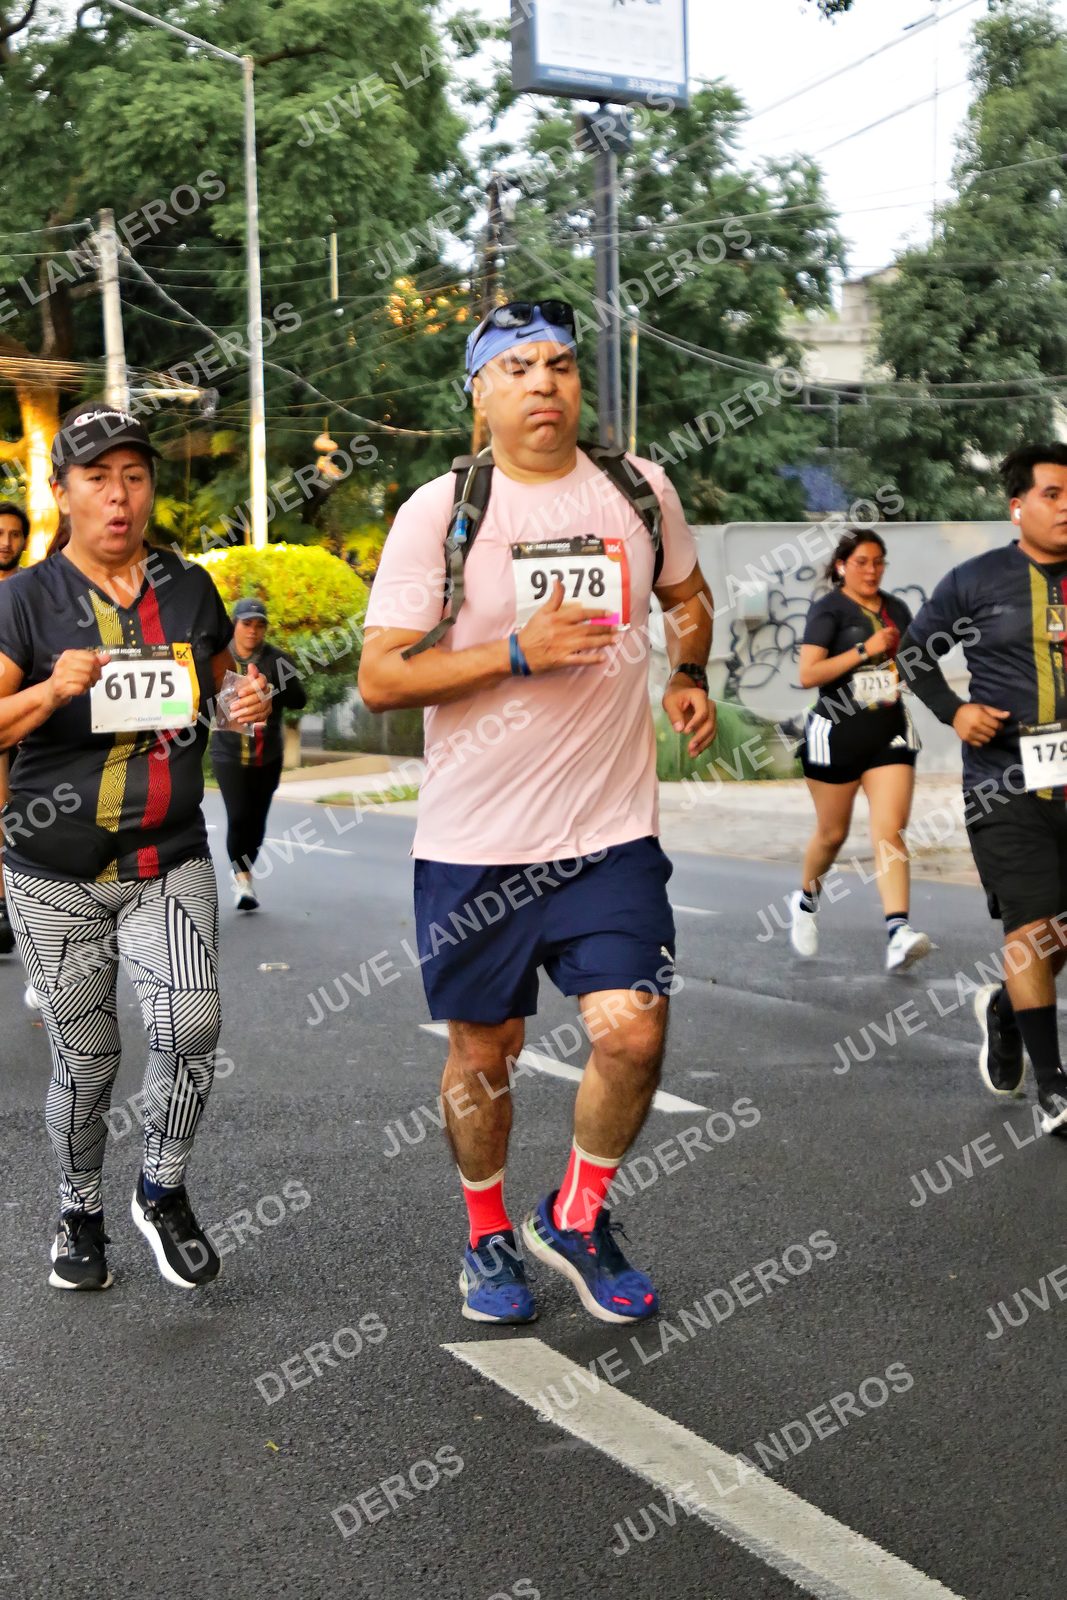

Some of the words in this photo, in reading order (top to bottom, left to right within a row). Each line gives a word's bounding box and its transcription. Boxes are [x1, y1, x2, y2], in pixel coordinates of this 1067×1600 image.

[105, 671, 175, 701] 6175
[861, 676, 890, 691] 7215
[1032, 740, 1067, 764] 179
